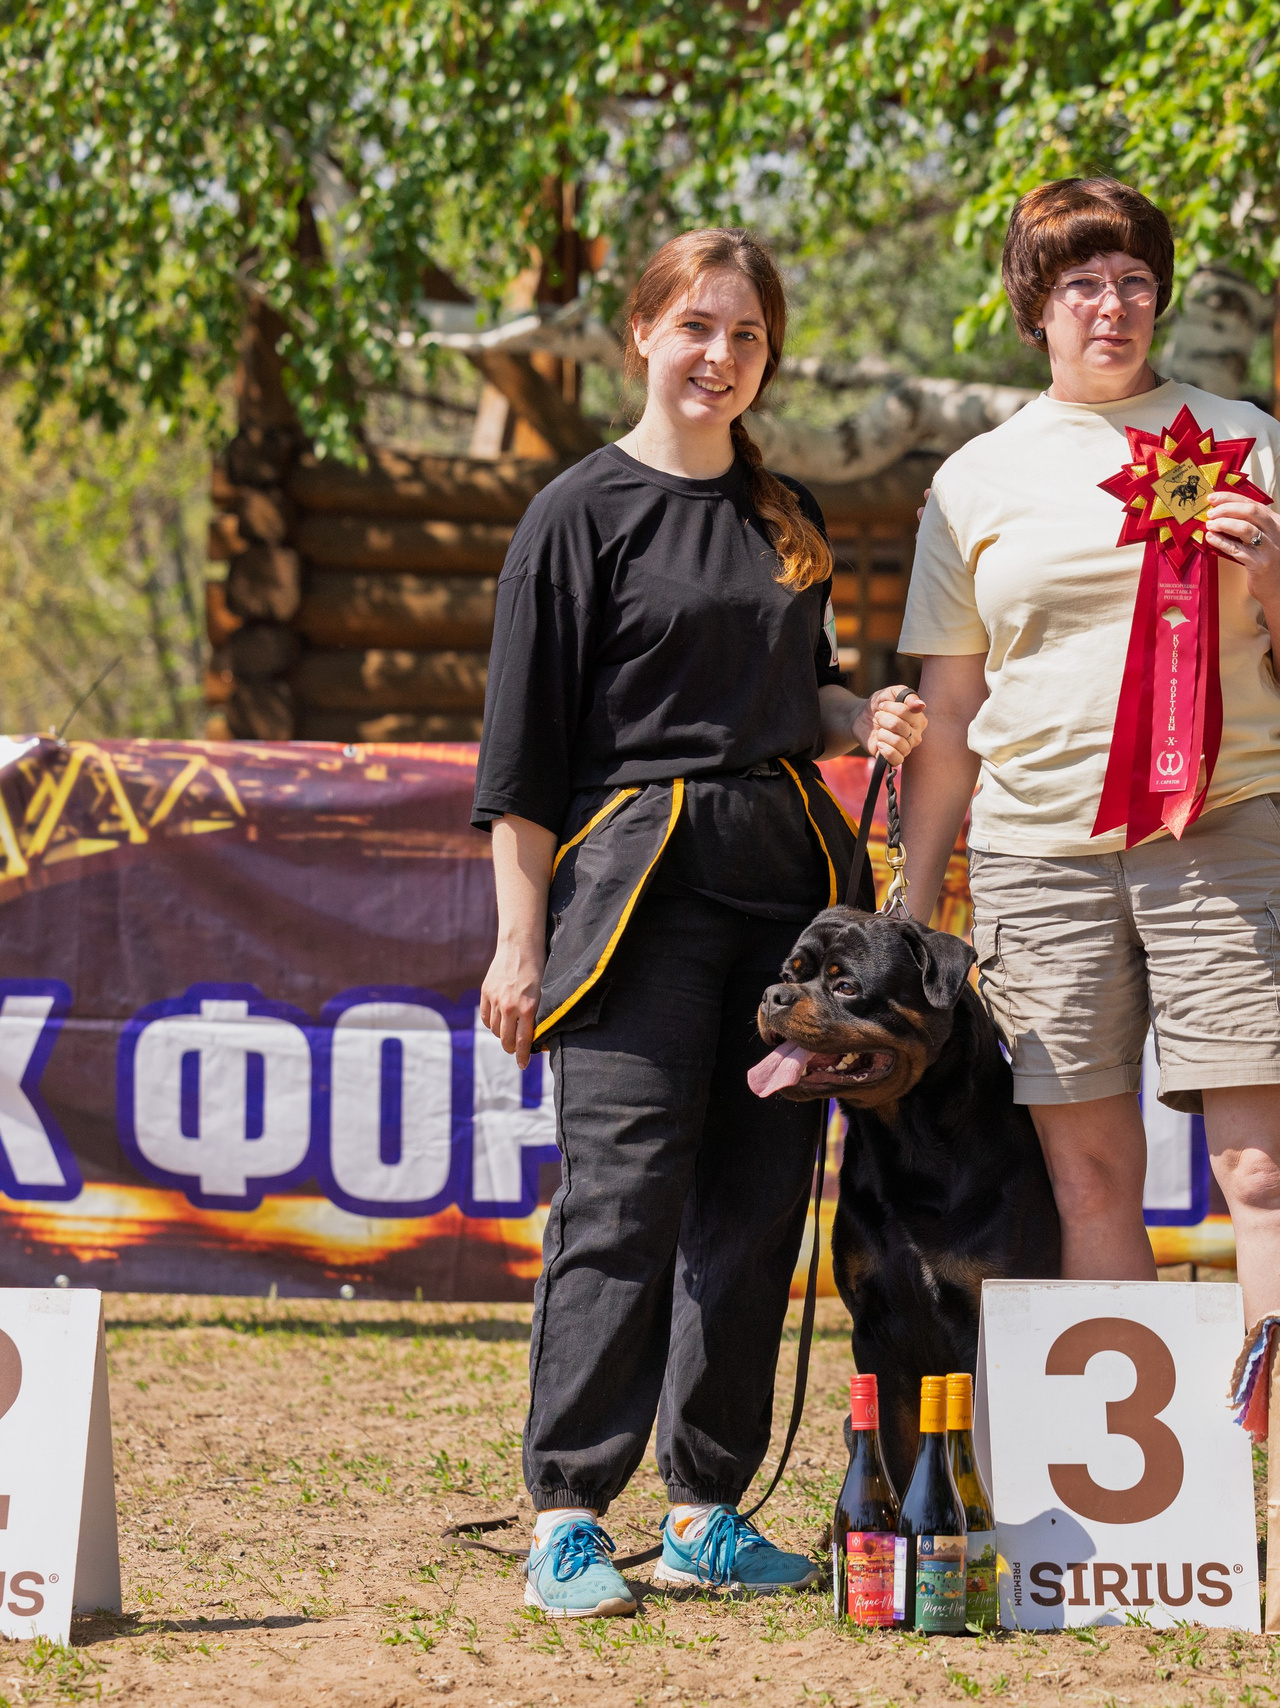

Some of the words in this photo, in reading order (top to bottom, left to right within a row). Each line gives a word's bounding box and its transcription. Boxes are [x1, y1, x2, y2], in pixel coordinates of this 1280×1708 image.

[1171, 634, 1180, 673] КУБОК
[1168, 678, 1178, 732] ФОРТУНЫ
[1045, 1317, 1185, 1525] 3
[1012, 1562, 1022, 1606] PREMIUM
